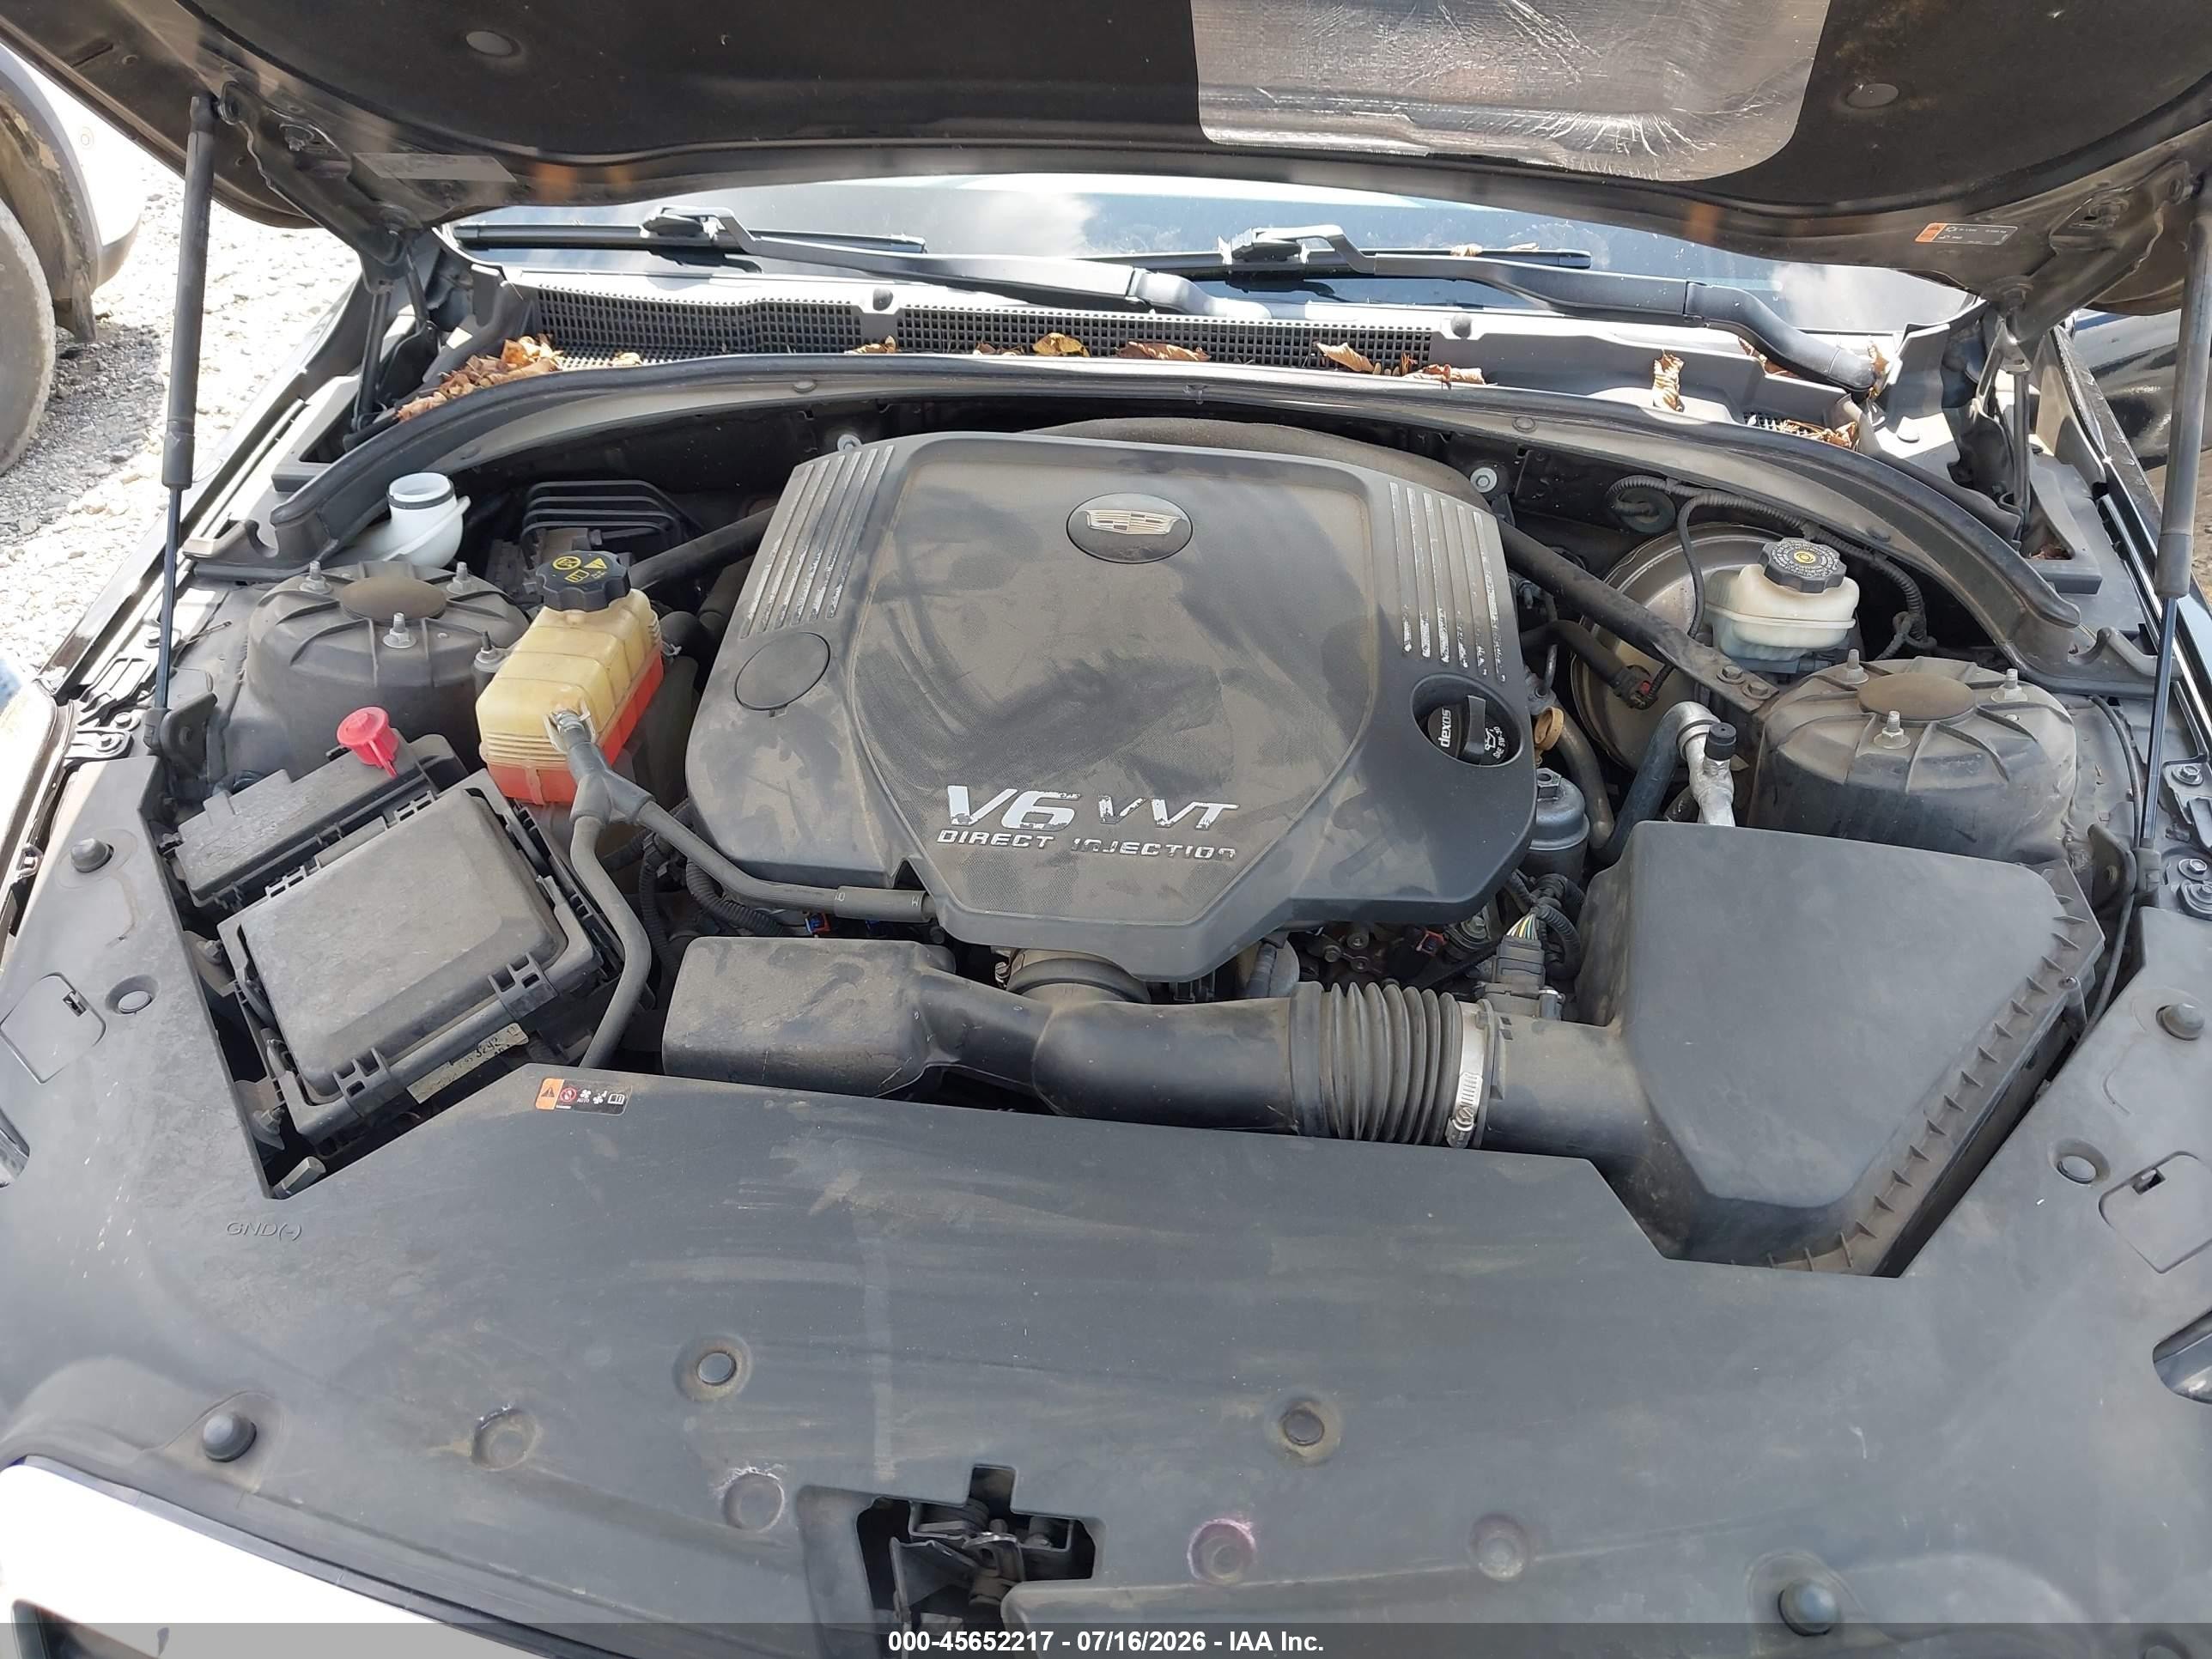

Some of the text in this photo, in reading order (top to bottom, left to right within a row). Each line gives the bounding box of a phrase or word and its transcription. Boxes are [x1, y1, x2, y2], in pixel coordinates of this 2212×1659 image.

[1438, 707, 1451, 747] dexos
[1492, 747, 1504, 759] SAE
[947, 785, 1240, 832] V6 VVT
[937, 830, 1054, 849] DIRECT
[227, 1221, 302, 1242] GND(-)
